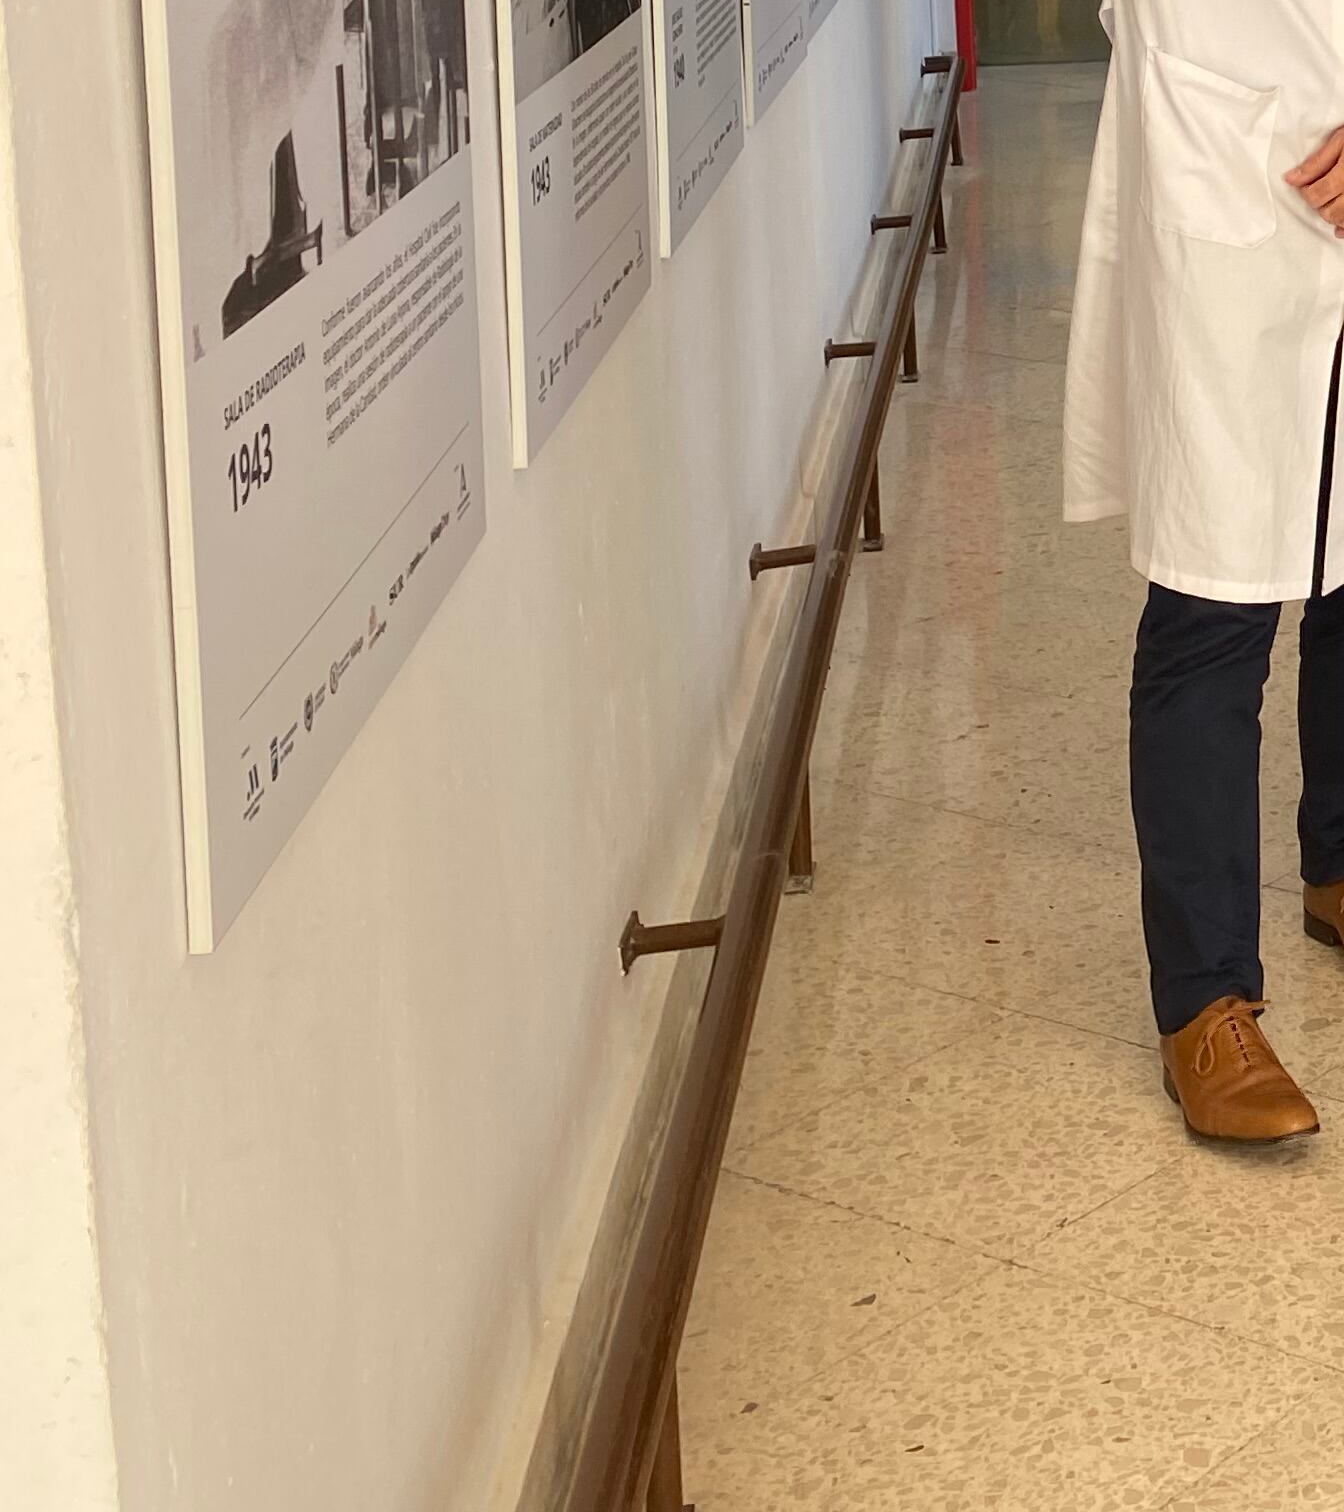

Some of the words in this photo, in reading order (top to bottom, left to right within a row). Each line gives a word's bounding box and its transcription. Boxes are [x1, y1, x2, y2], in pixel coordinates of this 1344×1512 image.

[223, 395, 244, 431] SALA
[244, 385, 256, 414] DE
[255, 341, 306, 402] RADIOTERAPIA
[228, 423, 273, 513] 1943
